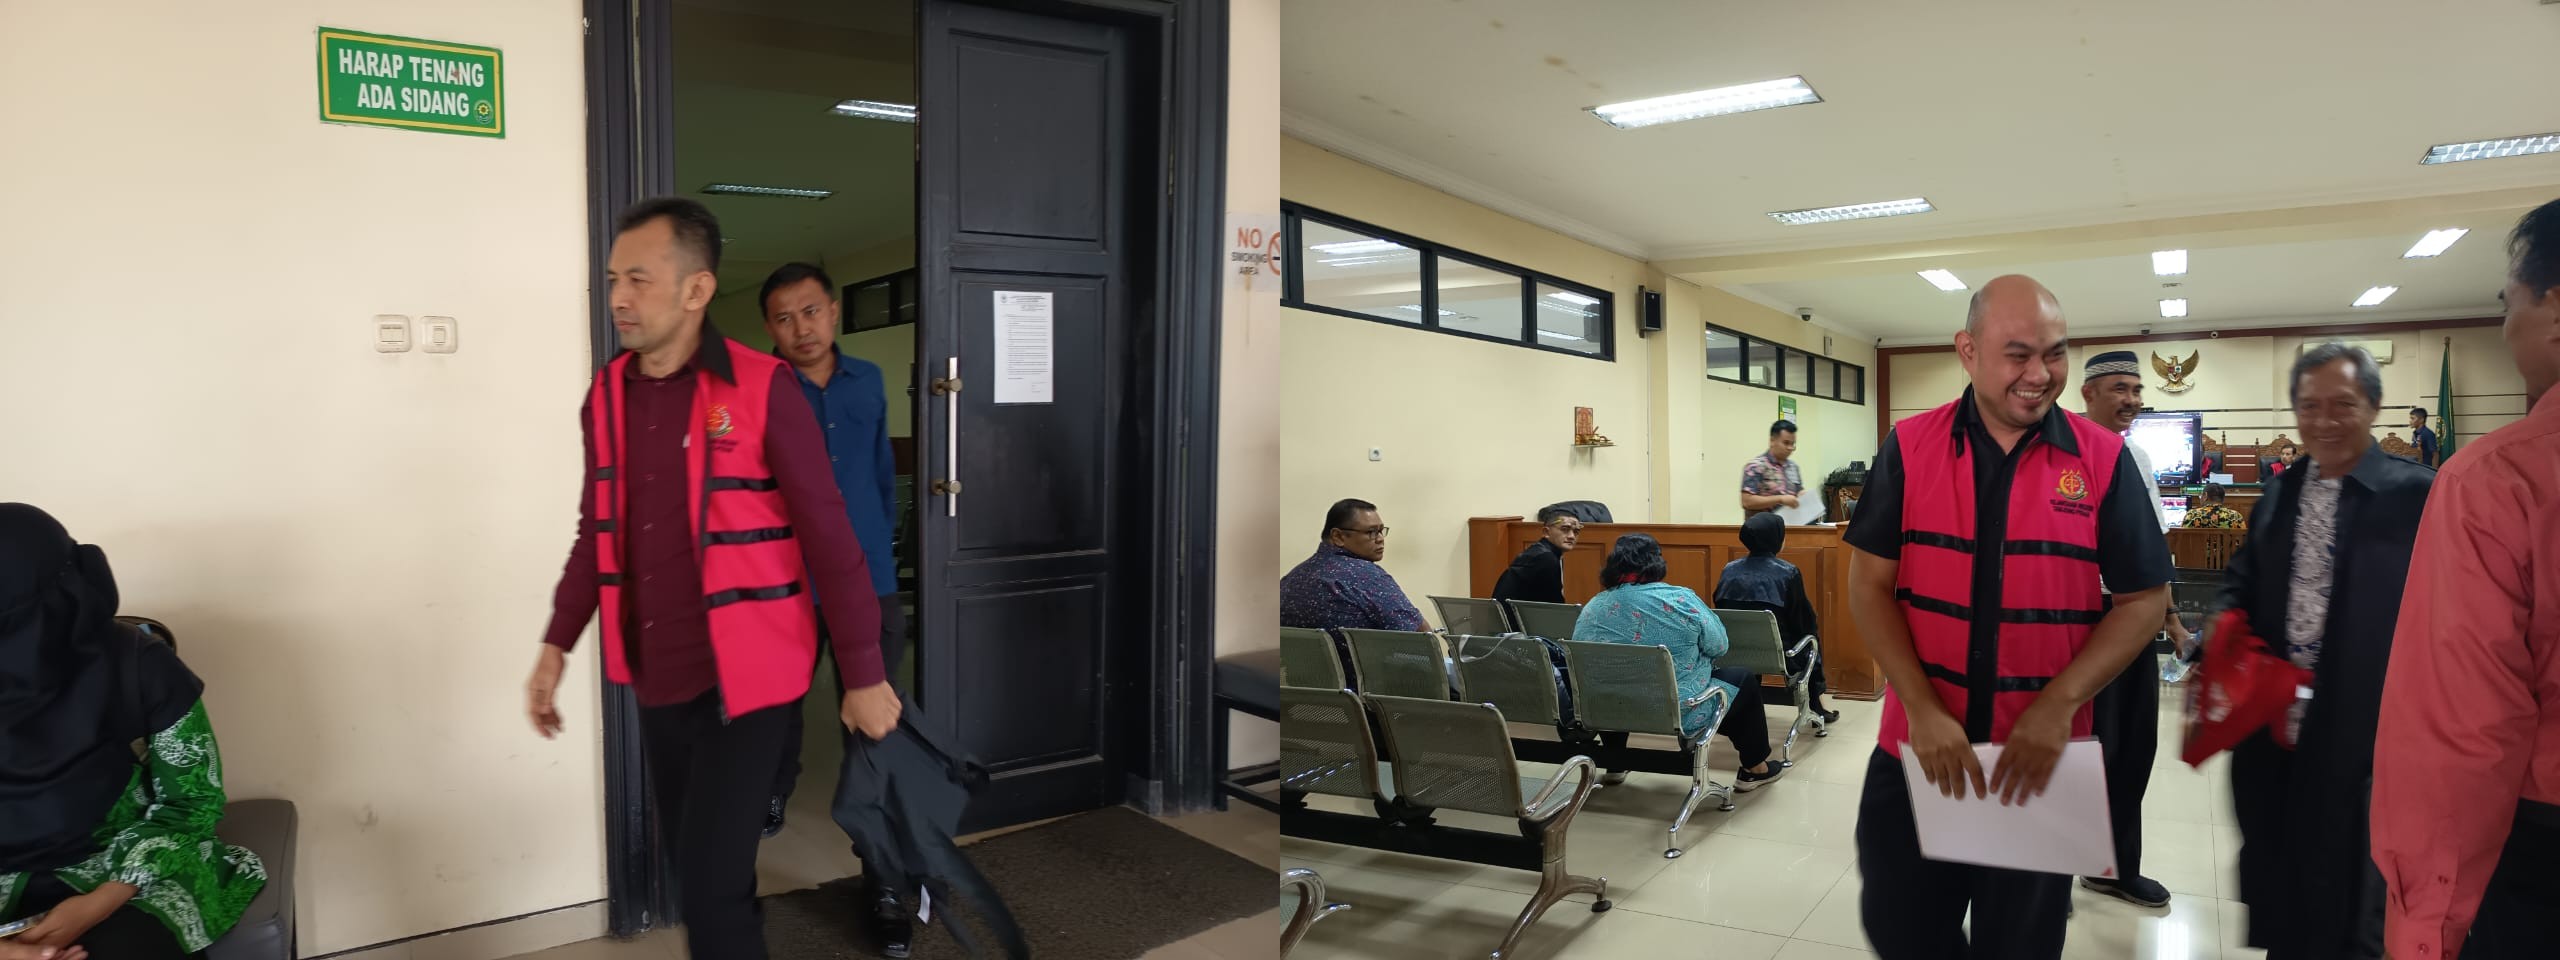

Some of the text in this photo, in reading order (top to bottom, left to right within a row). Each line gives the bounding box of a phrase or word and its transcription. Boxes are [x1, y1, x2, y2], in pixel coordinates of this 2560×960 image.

[338, 48, 485, 88] HARAP TENANG
[357, 83, 470, 117] ADA SIDANG
[1237, 227, 1263, 249] NO
